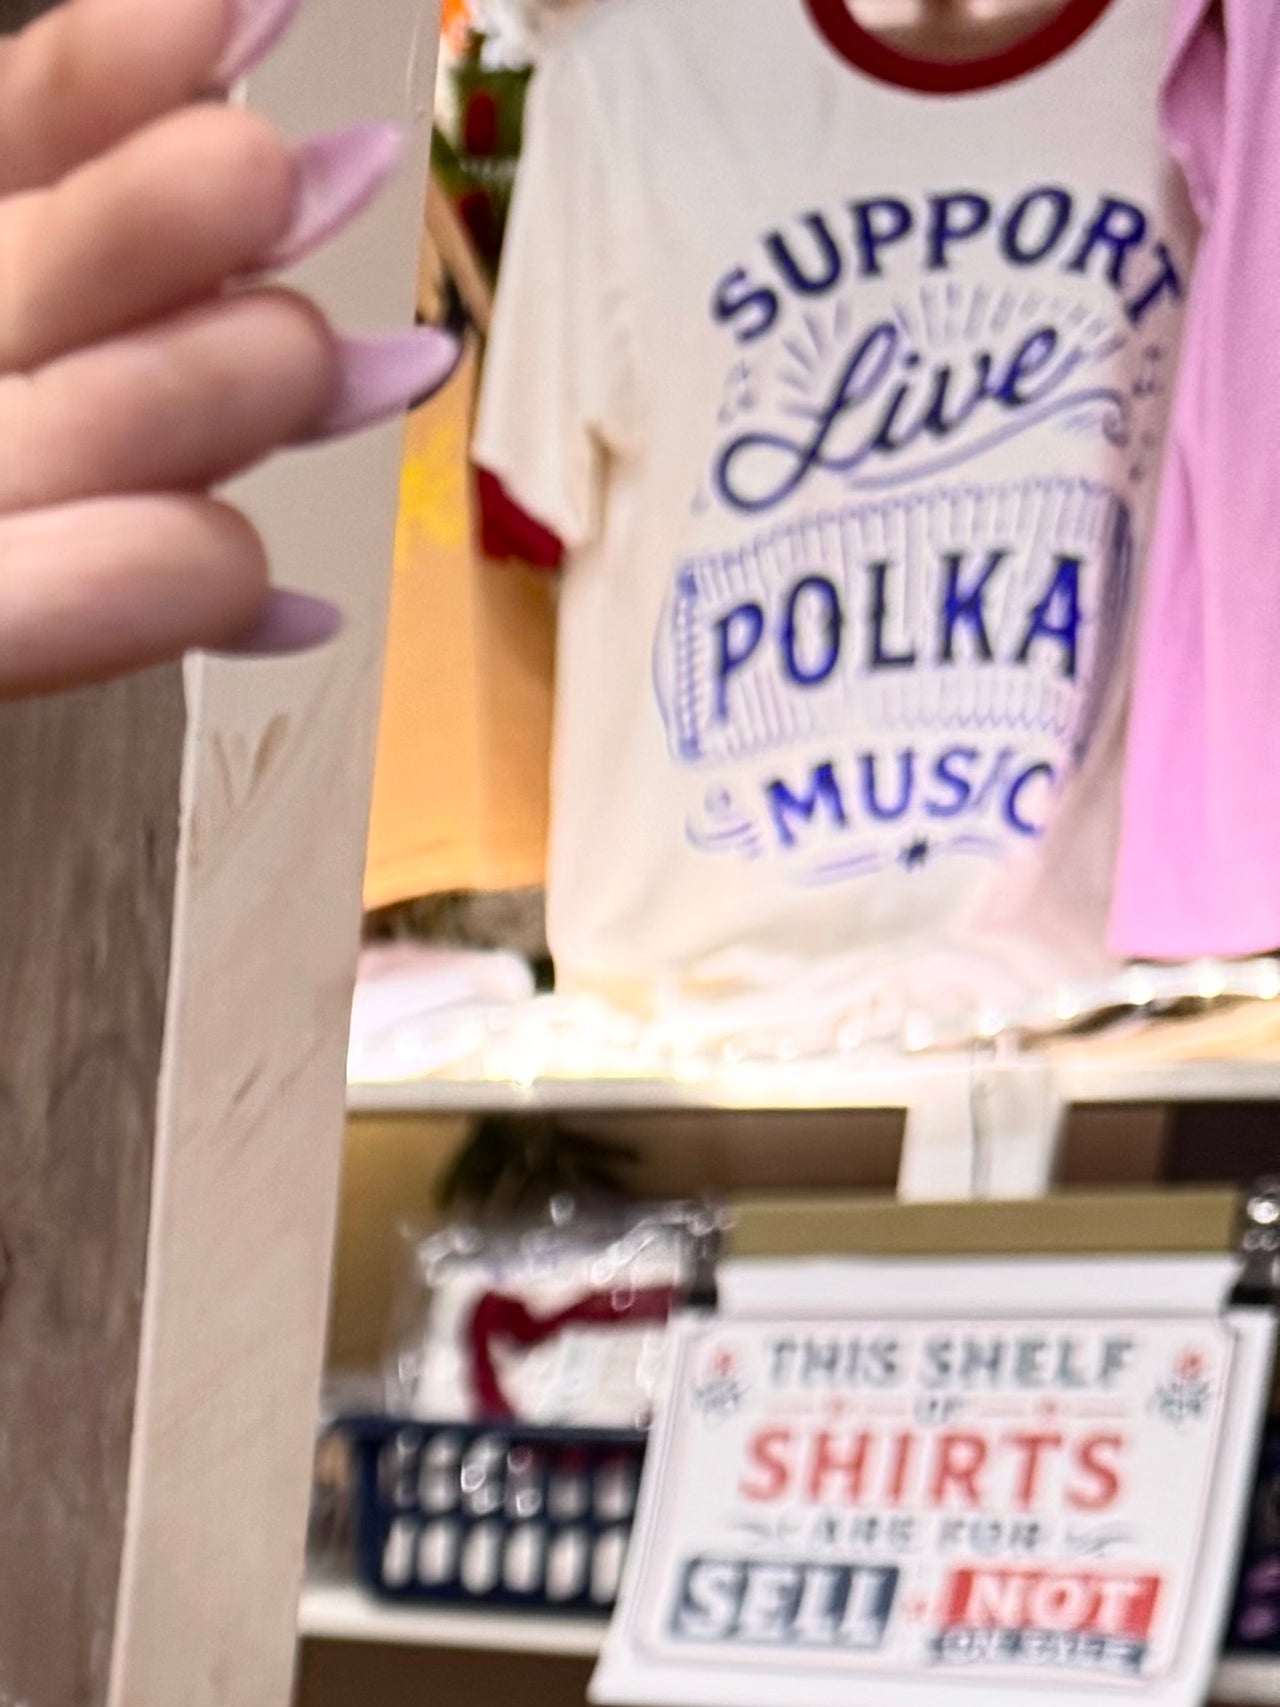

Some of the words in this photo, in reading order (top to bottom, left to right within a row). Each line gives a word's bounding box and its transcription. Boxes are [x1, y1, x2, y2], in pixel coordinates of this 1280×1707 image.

[711, 186, 1192, 344] SUPPORT
[715, 322, 1092, 516] Live
[710, 547, 1086, 723] POLKA
[764, 740, 1066, 850] MUSIC
[769, 1338, 900, 1386] THIS
[921, 1338, 1136, 1391] SHELF
[739, 1426, 1125, 1512] SHIRTS
[676, 1562, 890, 1646] SELL
[960, 1573, 1144, 1634] NOT
